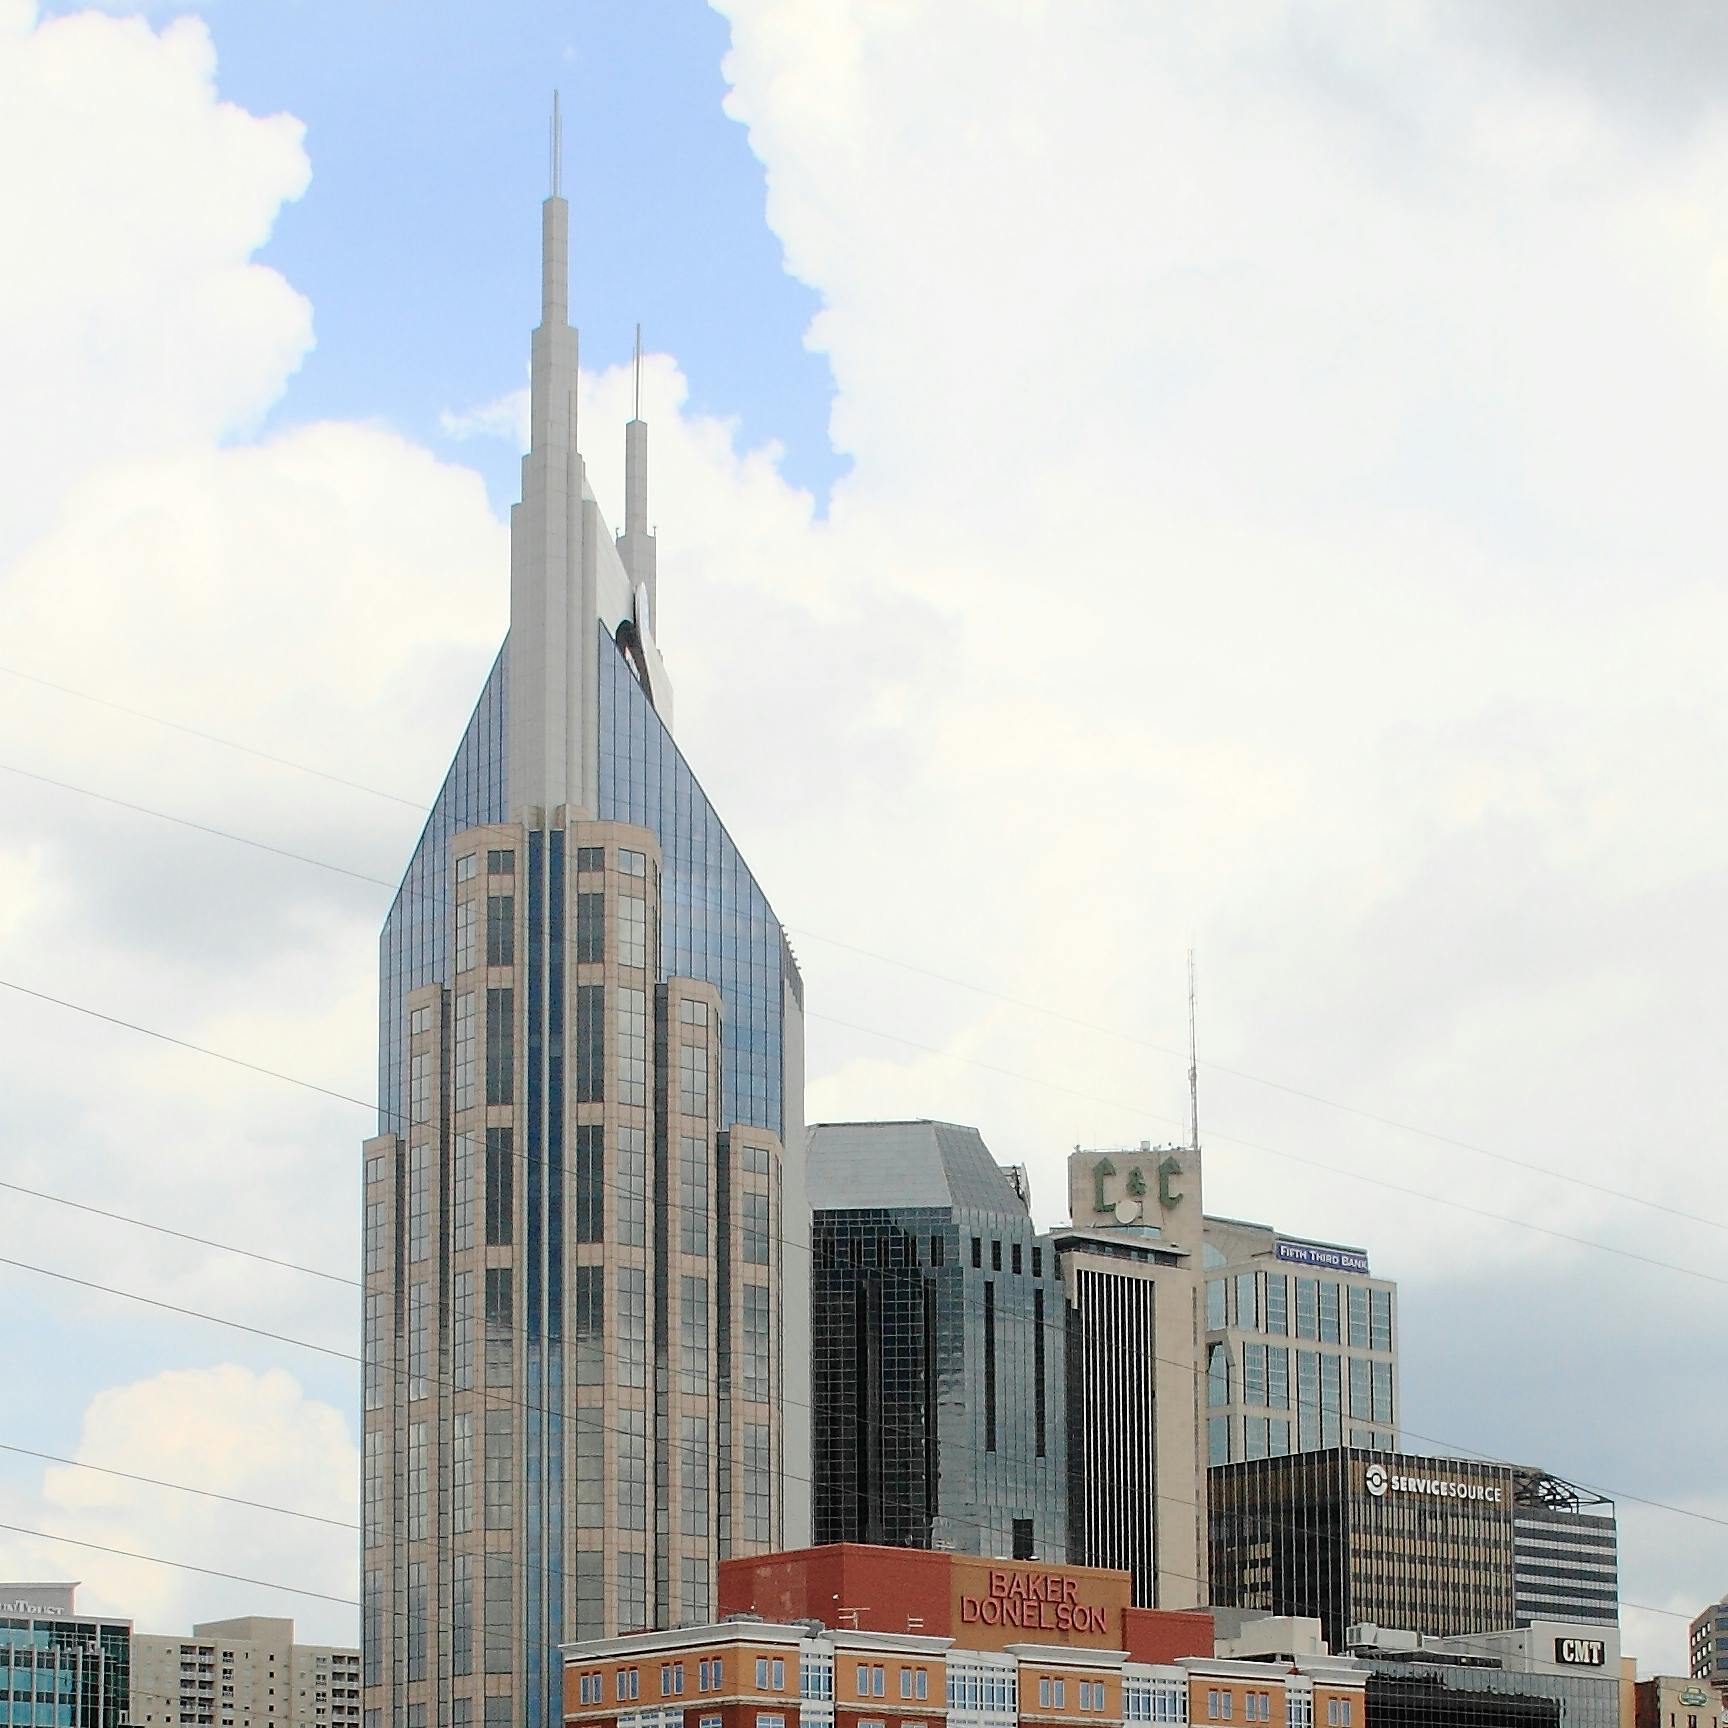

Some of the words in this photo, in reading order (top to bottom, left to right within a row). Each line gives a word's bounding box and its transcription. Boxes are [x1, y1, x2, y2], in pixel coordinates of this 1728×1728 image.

[1280, 1245, 1307, 1260] FIFTH
[1309, 1250, 1339, 1264] THIRD
[1341, 1256, 1368, 1269] BANK
[1391, 1475, 1502, 1502] SERVICESOURCE
[989, 1570, 1078, 1605] BAKER
[961, 1596, 1107, 1634] DONELSON
[1562, 1639, 1601, 1664] CMT
